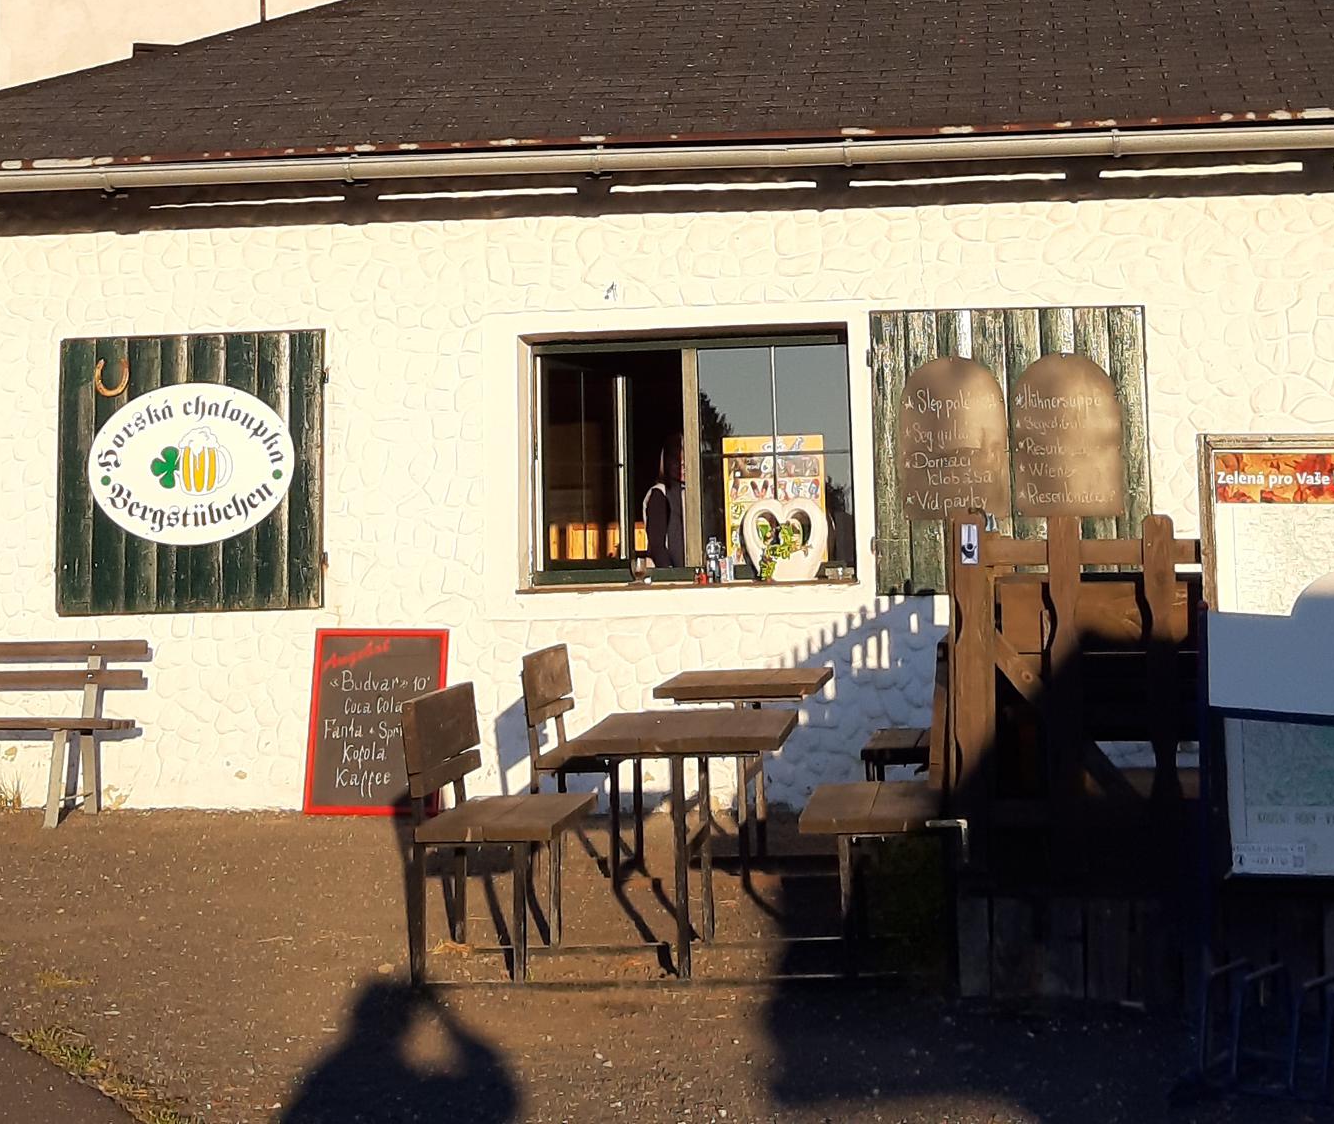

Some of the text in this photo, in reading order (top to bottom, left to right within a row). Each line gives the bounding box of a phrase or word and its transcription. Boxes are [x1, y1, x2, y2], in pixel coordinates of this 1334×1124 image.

[97, 394, 285, 472] Horská chaloupka
[1217, 471, 1265, 486] Zelená
[1268, 474, 1293, 489] pro
[1296, 471, 1330, 486] Vaše
[106, 482, 275, 533] Bergstübchen
[344, 696, 403, 715] Coca Cola
[324, 718, 403, 745] Fanta Spri
[342, 741, 387, 769] Kofola
[335, 767, 391, 798] Kaffee
